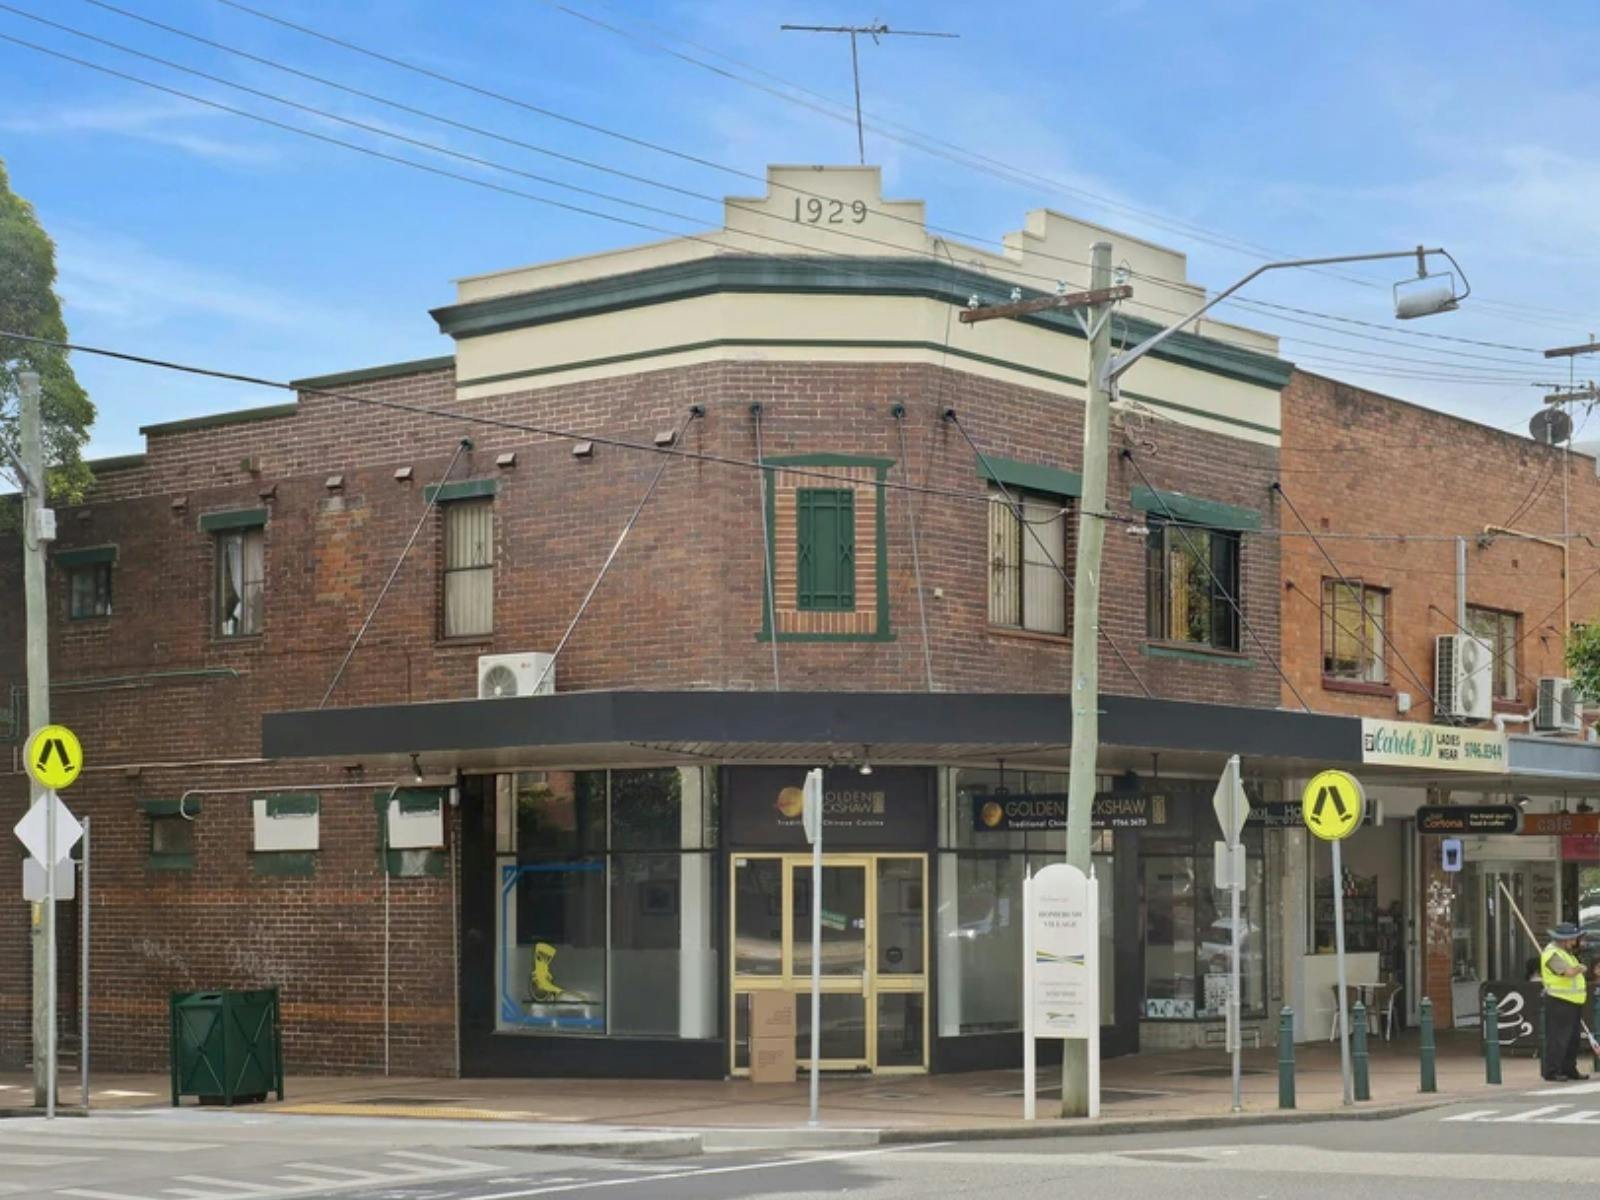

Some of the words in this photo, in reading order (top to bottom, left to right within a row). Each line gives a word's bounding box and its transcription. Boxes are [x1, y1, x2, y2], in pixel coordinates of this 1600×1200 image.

[795, 197, 867, 224] 1929
[1436, 734, 1461, 747] LADIES
[1438, 748, 1458, 760] WEAR
[825, 791, 872, 802] OLDEN
[823, 802, 873, 814] CKSHAW
[1005, 801, 1065, 817] GOLDEN
[1092, 799, 1146, 815] KSHAW
[1048, 819, 1068, 828] Chine
